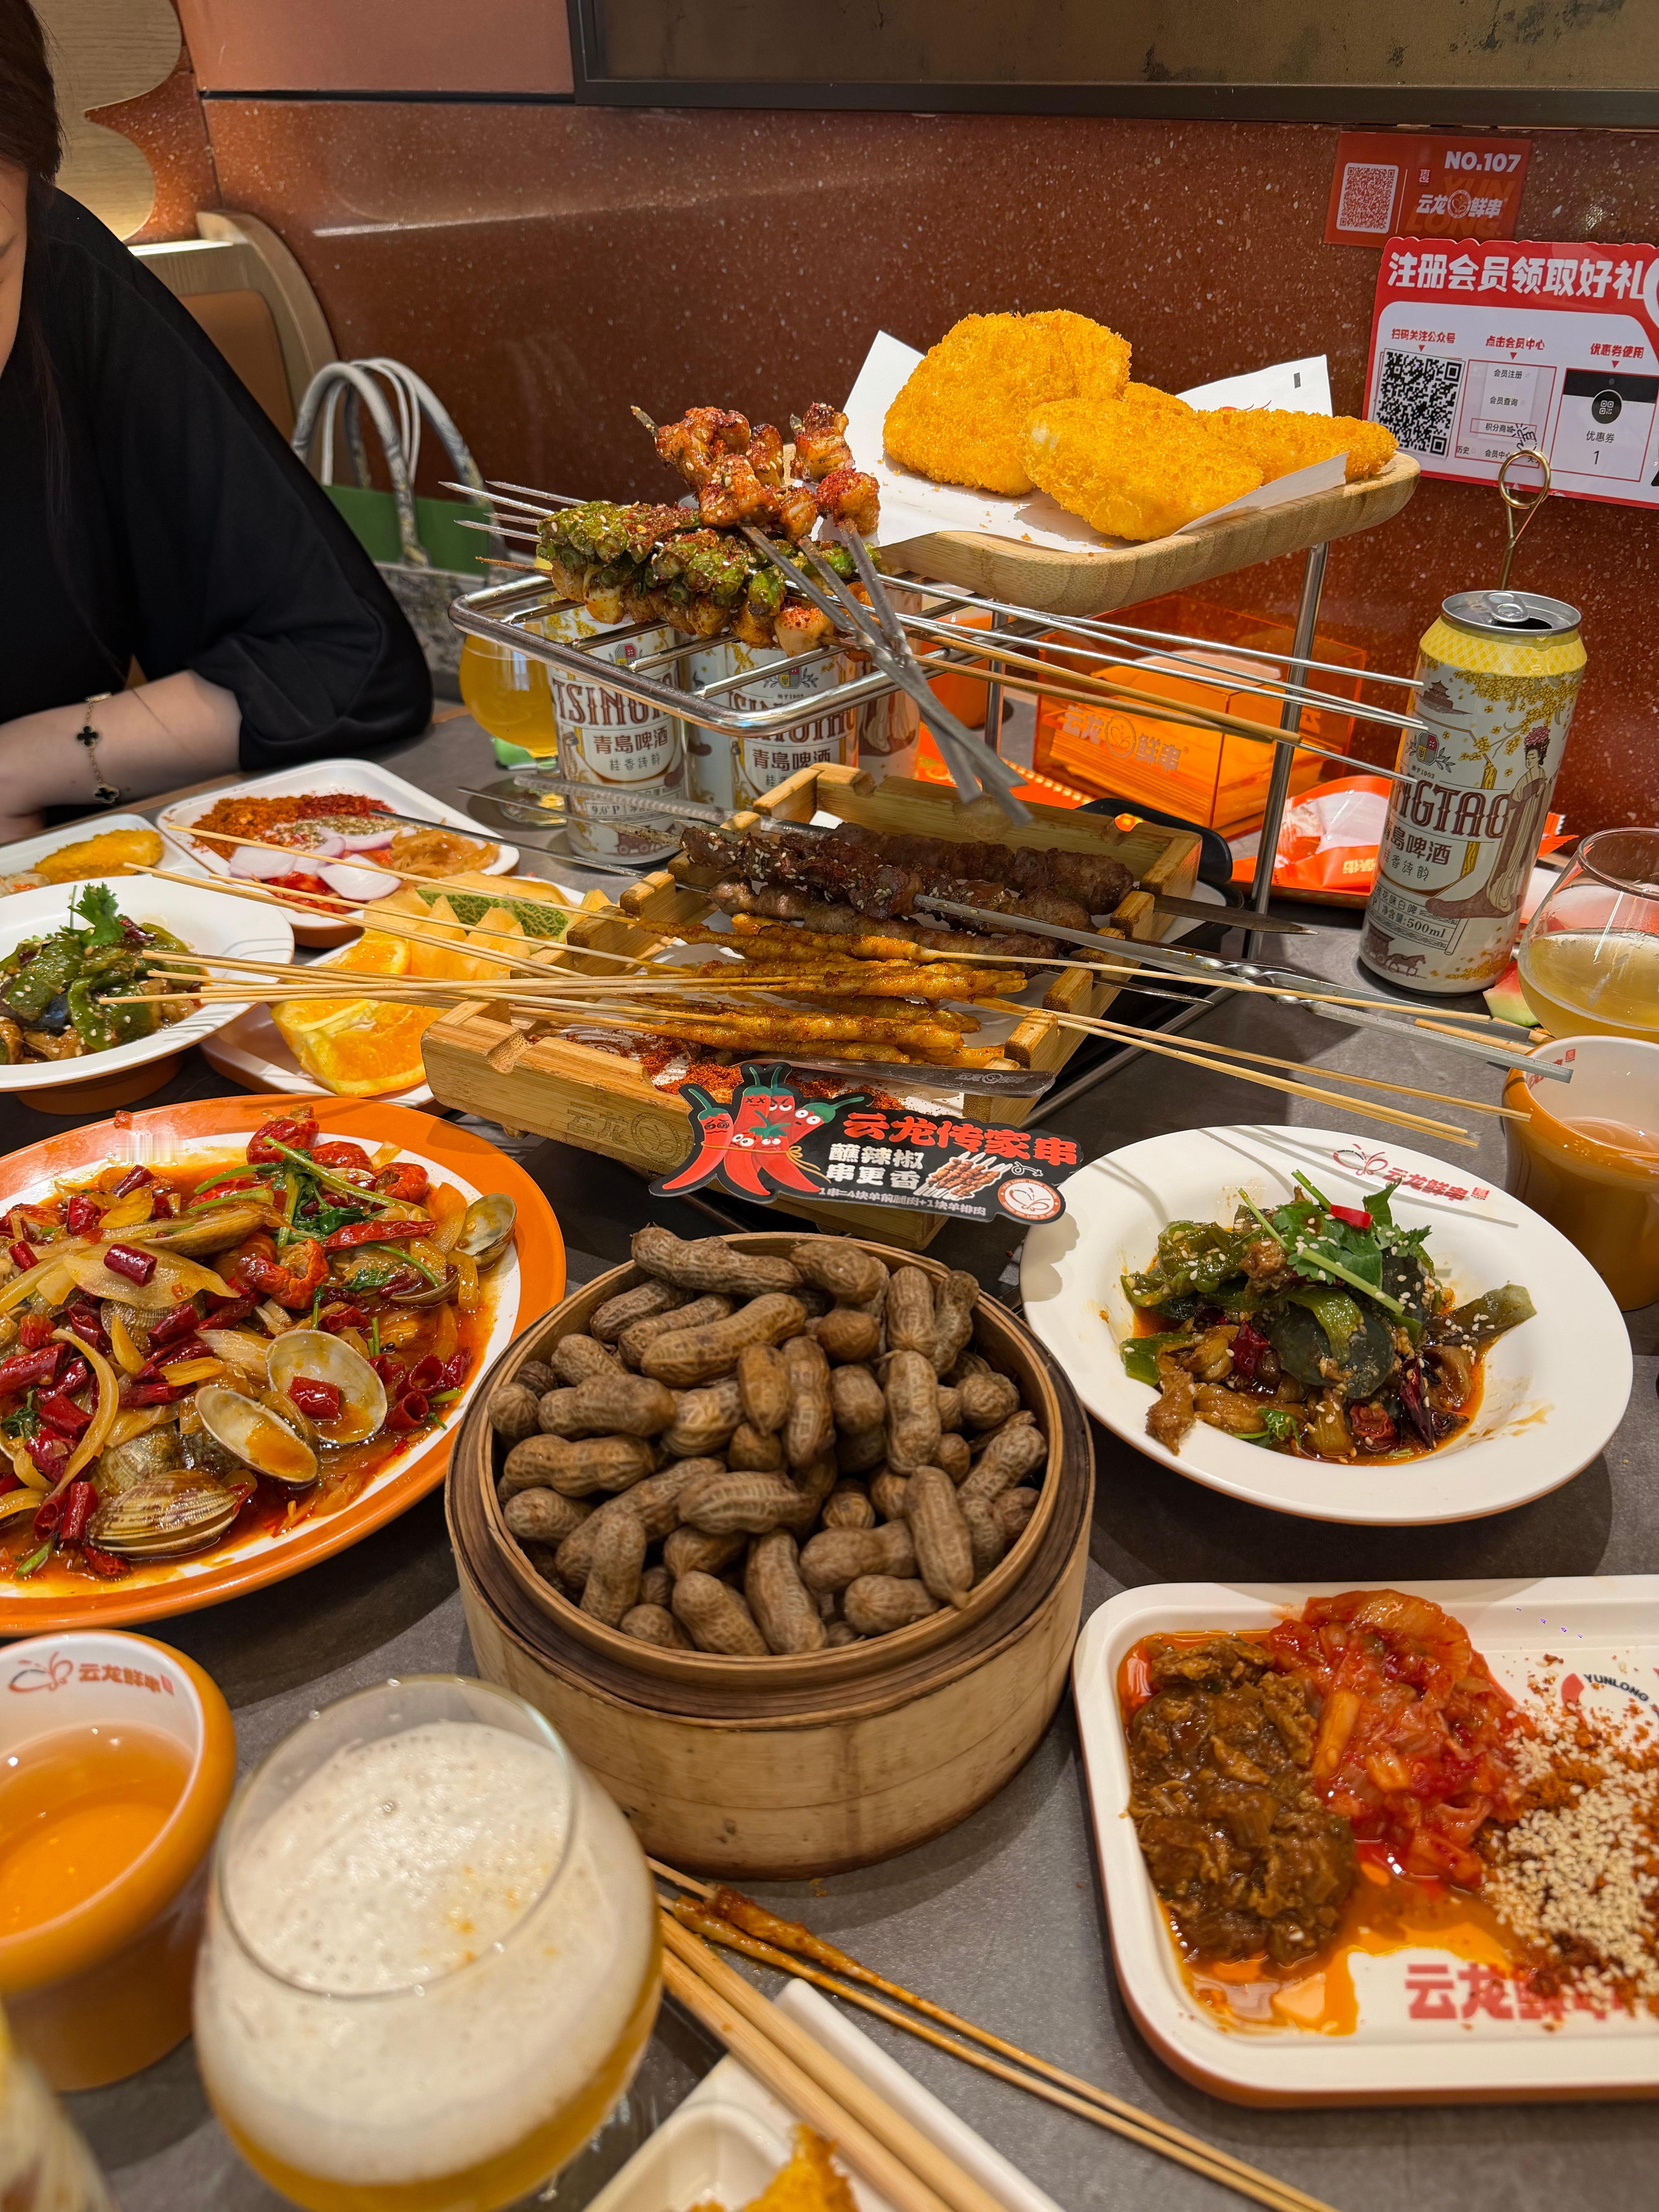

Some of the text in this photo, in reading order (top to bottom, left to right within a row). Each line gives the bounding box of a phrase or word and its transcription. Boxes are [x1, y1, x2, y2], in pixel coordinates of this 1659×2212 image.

[1444, 151, 1522, 172] NO.107
[1416, 194, 1503, 218] 云龙鲜串
[1388, 252, 1646, 300] 注册会员领取好礼
[1391, 328, 1456, 343] 扫码关注公众号
[1485, 335, 1545, 350] 点击会员中心
[1590, 343, 1644, 359] 优惠券使用
[1494, 369, 1522, 379] 会员注册
[1490, 396, 1518, 406] 会员查询
[1485, 422, 1513, 433] 积分商城
[1586, 430, 1615, 443] 优惠券
[1456, 446, 1470, 455] 历史
[1594, 450, 1600, 465] 1
[843, 1112, 1078, 1166] 云龙传家串
[826, 1163, 921, 1190] 串更香
[1382, 1167, 1469, 1201] 云龙鲜串
[1583, 1674, 1649, 1702] YUNLONG
